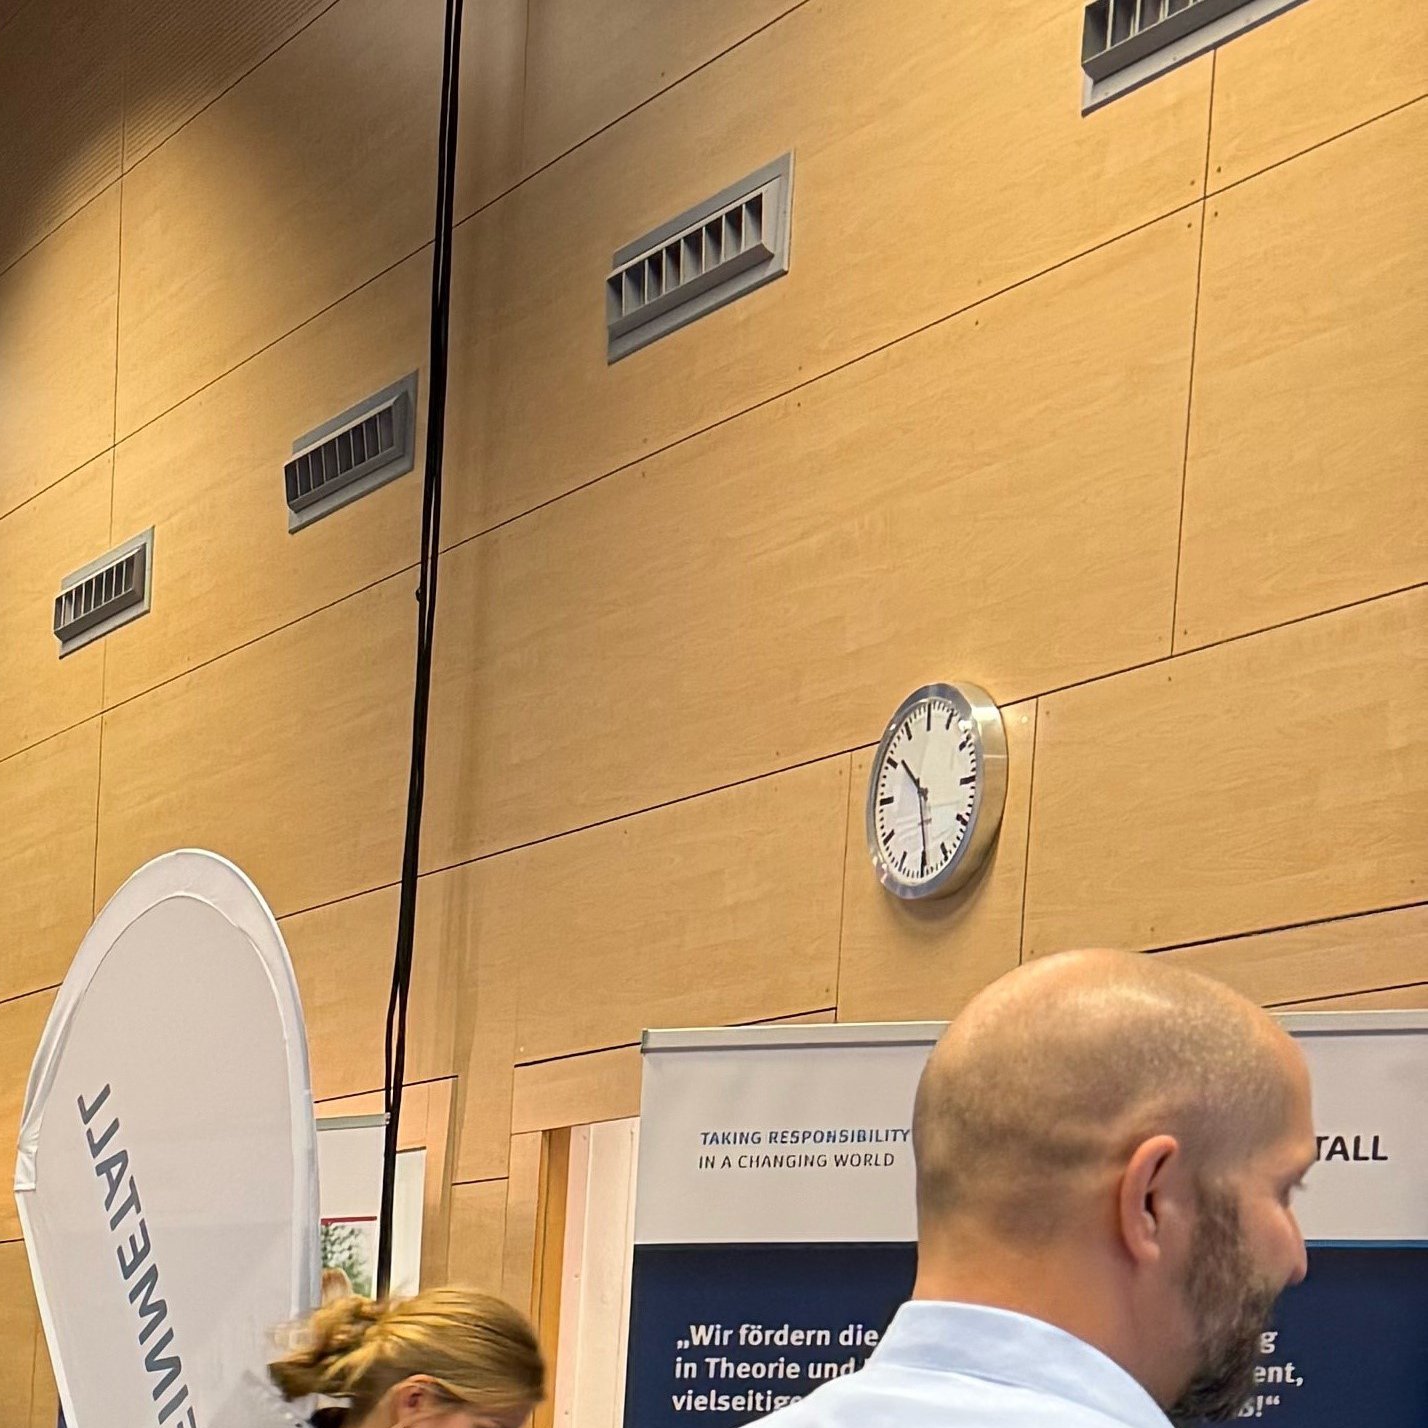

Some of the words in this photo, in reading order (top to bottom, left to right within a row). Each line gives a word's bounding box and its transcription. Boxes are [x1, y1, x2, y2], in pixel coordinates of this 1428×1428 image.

[701, 1131, 762, 1145] TAKING
[768, 1129, 910, 1144] RESPONSIBILITY
[699, 1156, 715, 1169] IN
[721, 1156, 732, 1168] A
[738, 1154, 828, 1168] CHANGING
[834, 1153, 895, 1167] WORLD
[739, 1324, 830, 1346] fördern
[839, 1324, 879, 1346] die
[675, 1357, 697, 1379] in
[704, 1357, 800, 1379] Theorie
[808, 1357, 855, 1379] und
